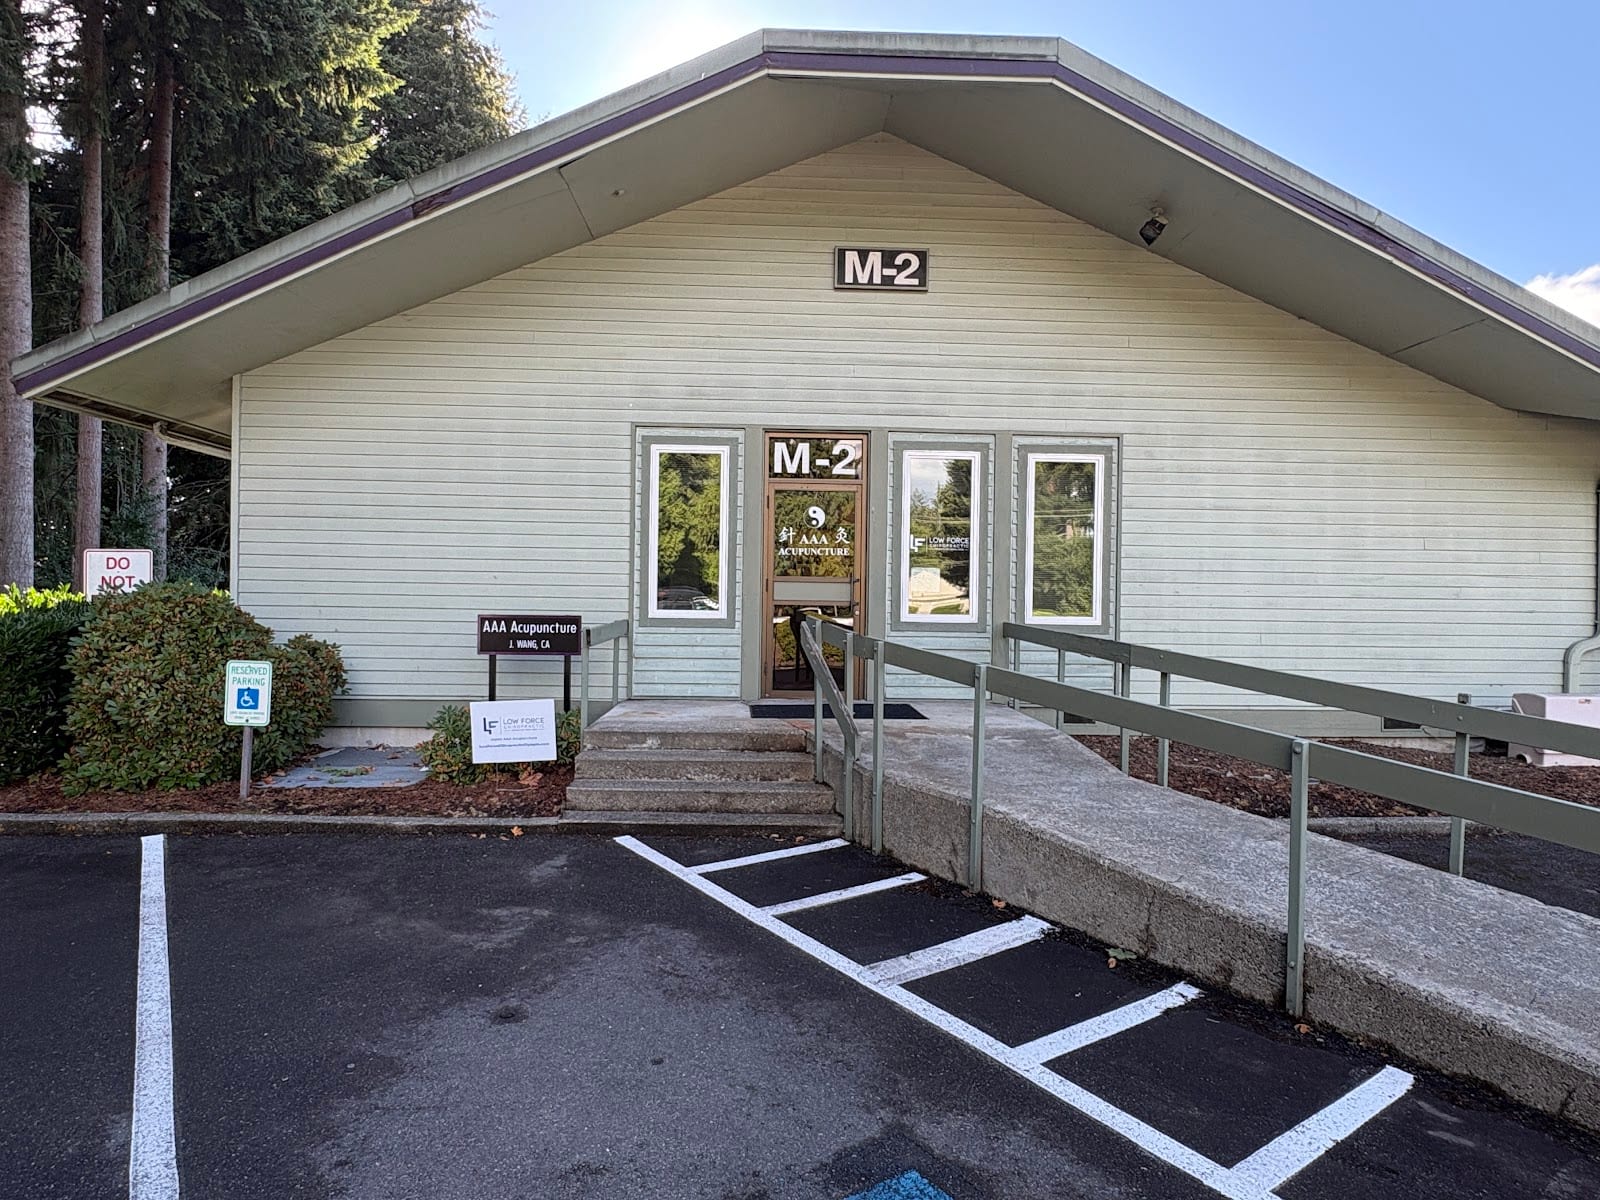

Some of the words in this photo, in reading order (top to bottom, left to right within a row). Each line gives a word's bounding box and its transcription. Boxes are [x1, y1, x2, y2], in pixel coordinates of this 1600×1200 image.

[844, 250, 920, 286] M-2
[773, 442, 857, 475] M-2
[779, 527, 796, 544] 針
[800, 534, 829, 545] AAA
[835, 526, 850, 544] 灸
[929, 536, 944, 544] LOW
[946, 536, 969, 544] FORCE
[778, 547, 850, 556] ACUPUNCTURE
[106, 557, 130, 570] DO
[101, 575, 136, 589] NOT
[482, 620, 507, 633] AAA
[510, 620, 577, 636] Acupuncture
[516, 639, 538, 650] WANG,
[541, 639, 551, 649] CA
[231, 666, 268, 675] RESERVED
[232, 677, 266, 686] PARKING
